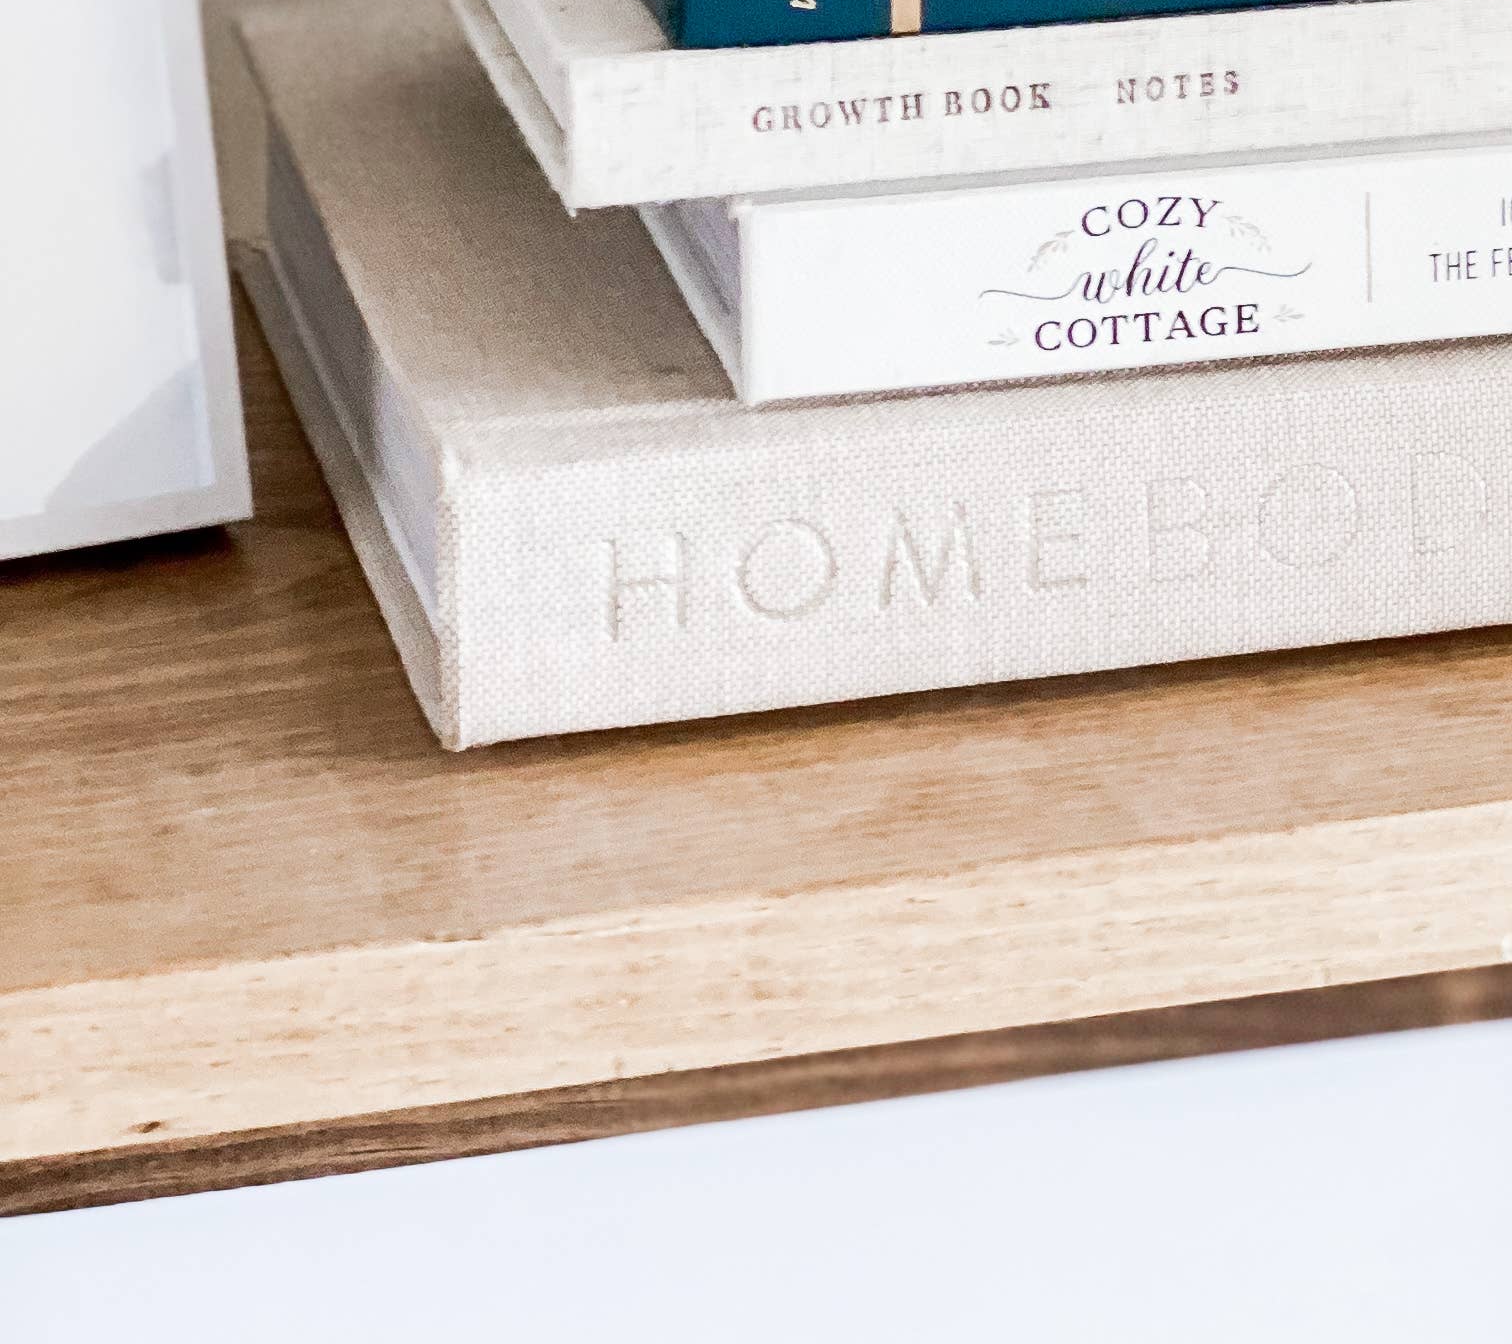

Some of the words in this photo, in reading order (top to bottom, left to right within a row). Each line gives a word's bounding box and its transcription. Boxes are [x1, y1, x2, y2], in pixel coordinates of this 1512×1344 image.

[752, 93, 923, 134] GROWTH
[944, 82, 1052, 117] BOOK
[1115, 70, 1241, 105] NOTES
[1080, 196, 1224, 237] COZY
[1429, 249, 1478, 282] THE
[1035, 304, 1260, 352] COTTAGE
